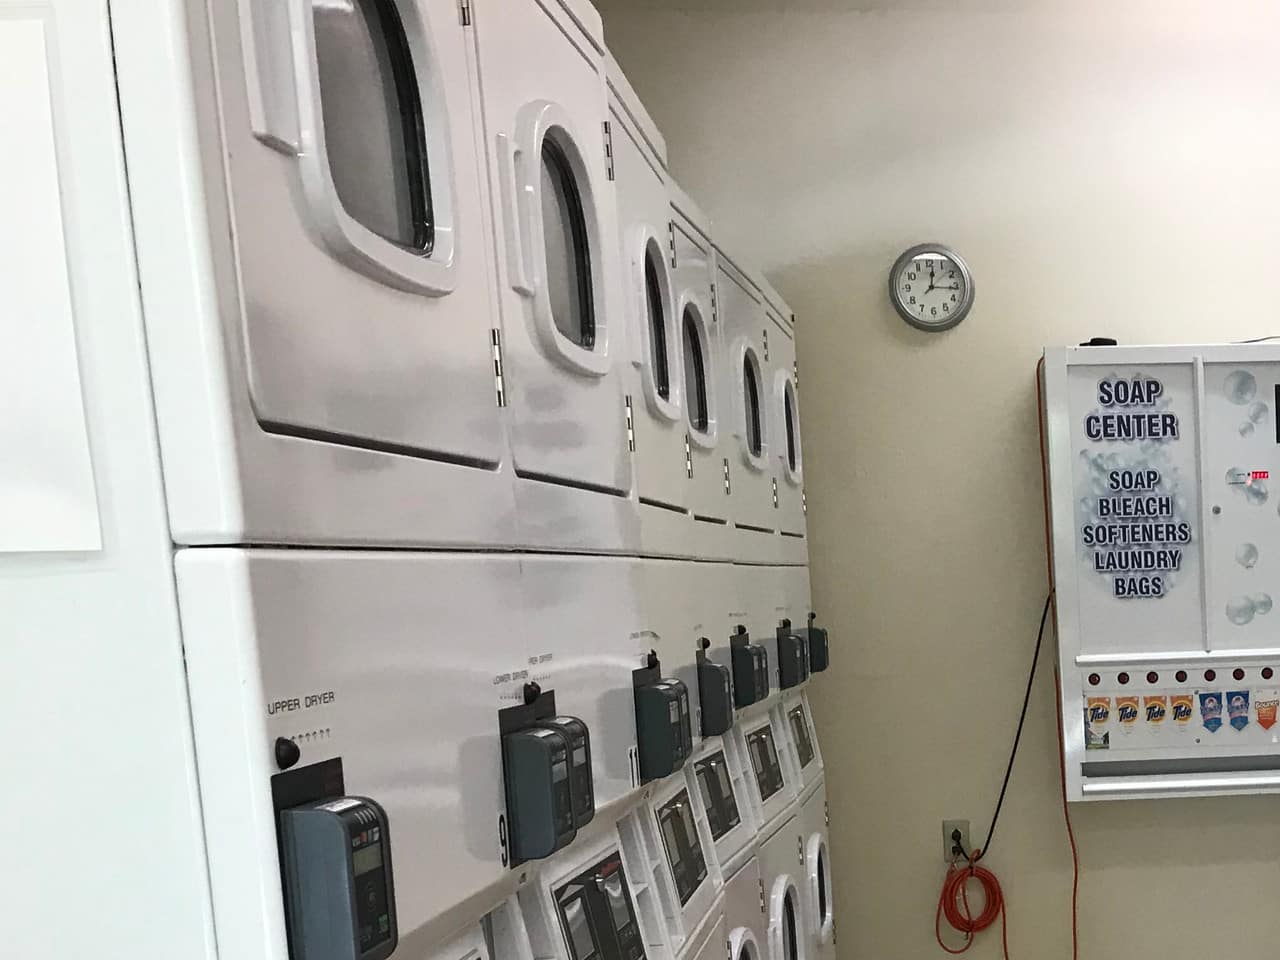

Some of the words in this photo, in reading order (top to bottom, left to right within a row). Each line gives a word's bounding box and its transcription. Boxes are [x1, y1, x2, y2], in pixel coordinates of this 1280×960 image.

[907, 272, 916, 281] 10
[1099, 380, 1161, 404] SOAP
[1086, 414, 1177, 438] CENTER
[1109, 471, 1159, 489] SOAP
[1099, 497, 1171, 516] BLEACH
[1083, 523, 1189, 545] SOFTENERS
[1095, 550, 1180, 571] LAUNDRY
[1114, 577, 1162, 596] BAGS
[267, 698, 301, 715] UPPER
[304, 691, 335, 708] DRYER
[1173, 704, 1192, 720] Tide
[1089, 707, 1109, 722] Tide
[1118, 706, 1138, 722] Tide
[1146, 705, 1166, 721] Tide
[499, 814, 508, 868] 9
